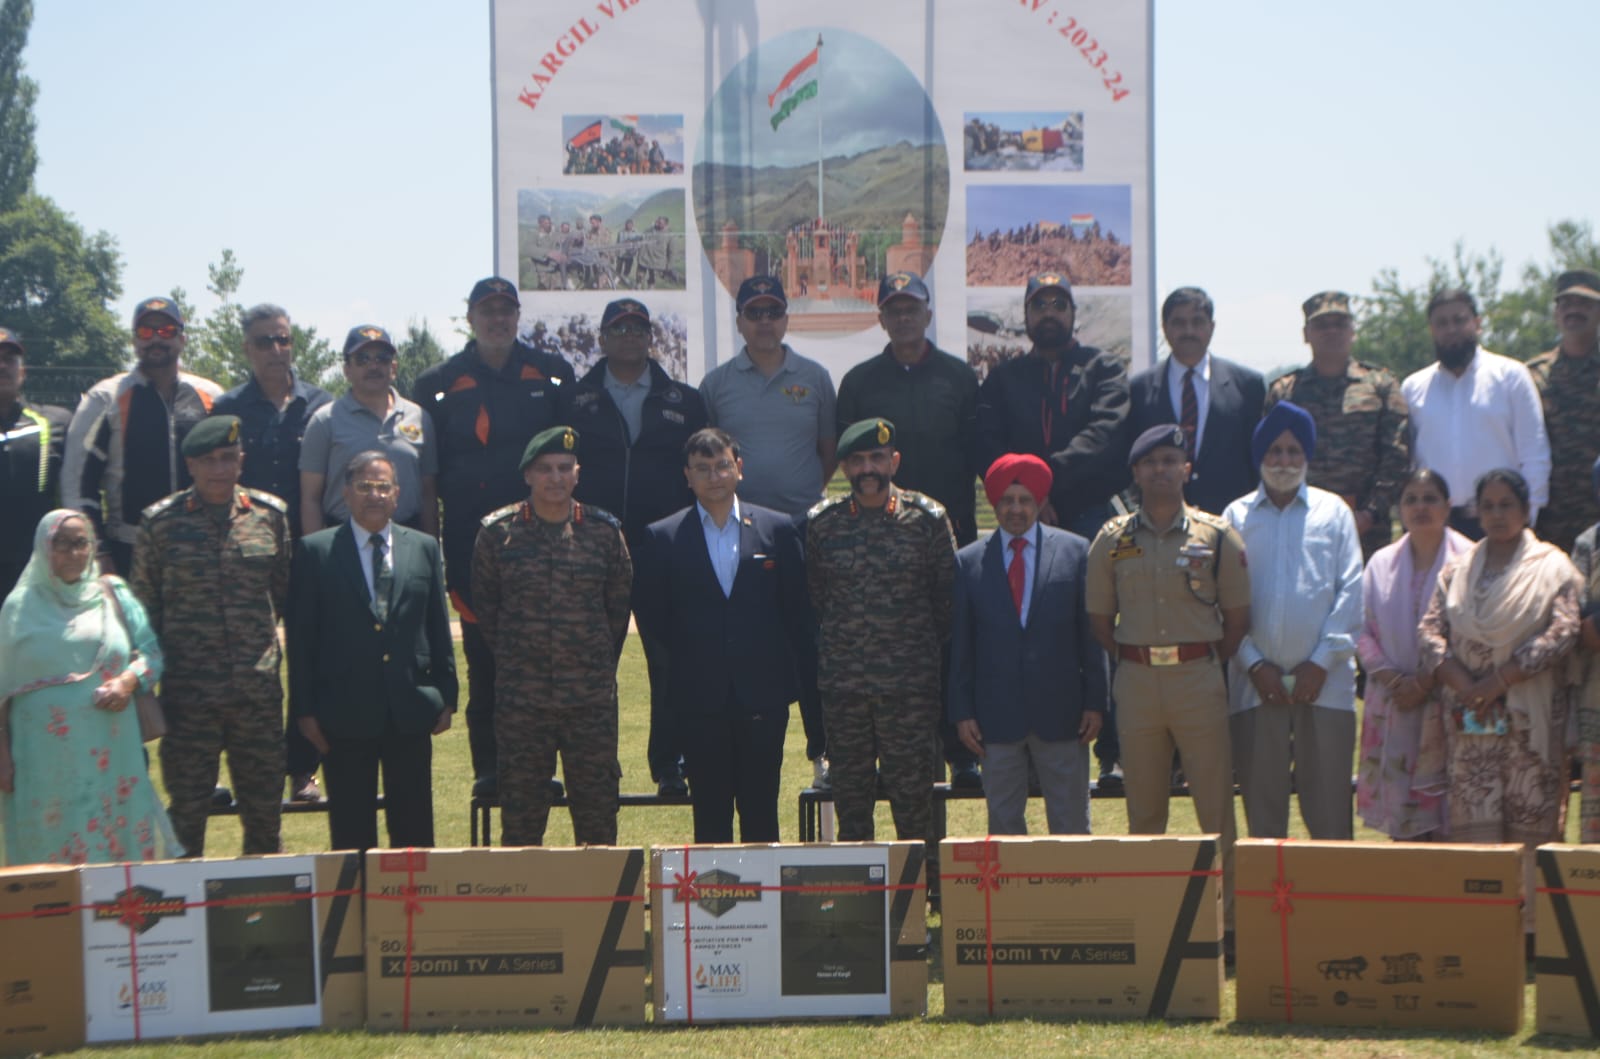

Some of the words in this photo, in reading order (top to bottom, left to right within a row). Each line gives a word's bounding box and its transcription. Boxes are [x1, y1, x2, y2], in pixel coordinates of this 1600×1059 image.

[517, 17, 600, 110] KARGIL
[596, 0, 640, 19] VI
[1058, 16, 1131, 102] 2023-24
[475, 883, 513, 896] Google
[514, 883, 528, 893] TV
[955, 928, 976, 941] 80
[380, 939, 400, 953] 80
[1040, 947, 1061, 961] TV
[1071, 948, 1081, 960] A
[1086, 947, 1129, 961] Series
[466, 958, 489, 972] TV
[499, 959, 509, 970] A
[513, 957, 557, 971] Series
[710, 963, 741, 976] MAX
